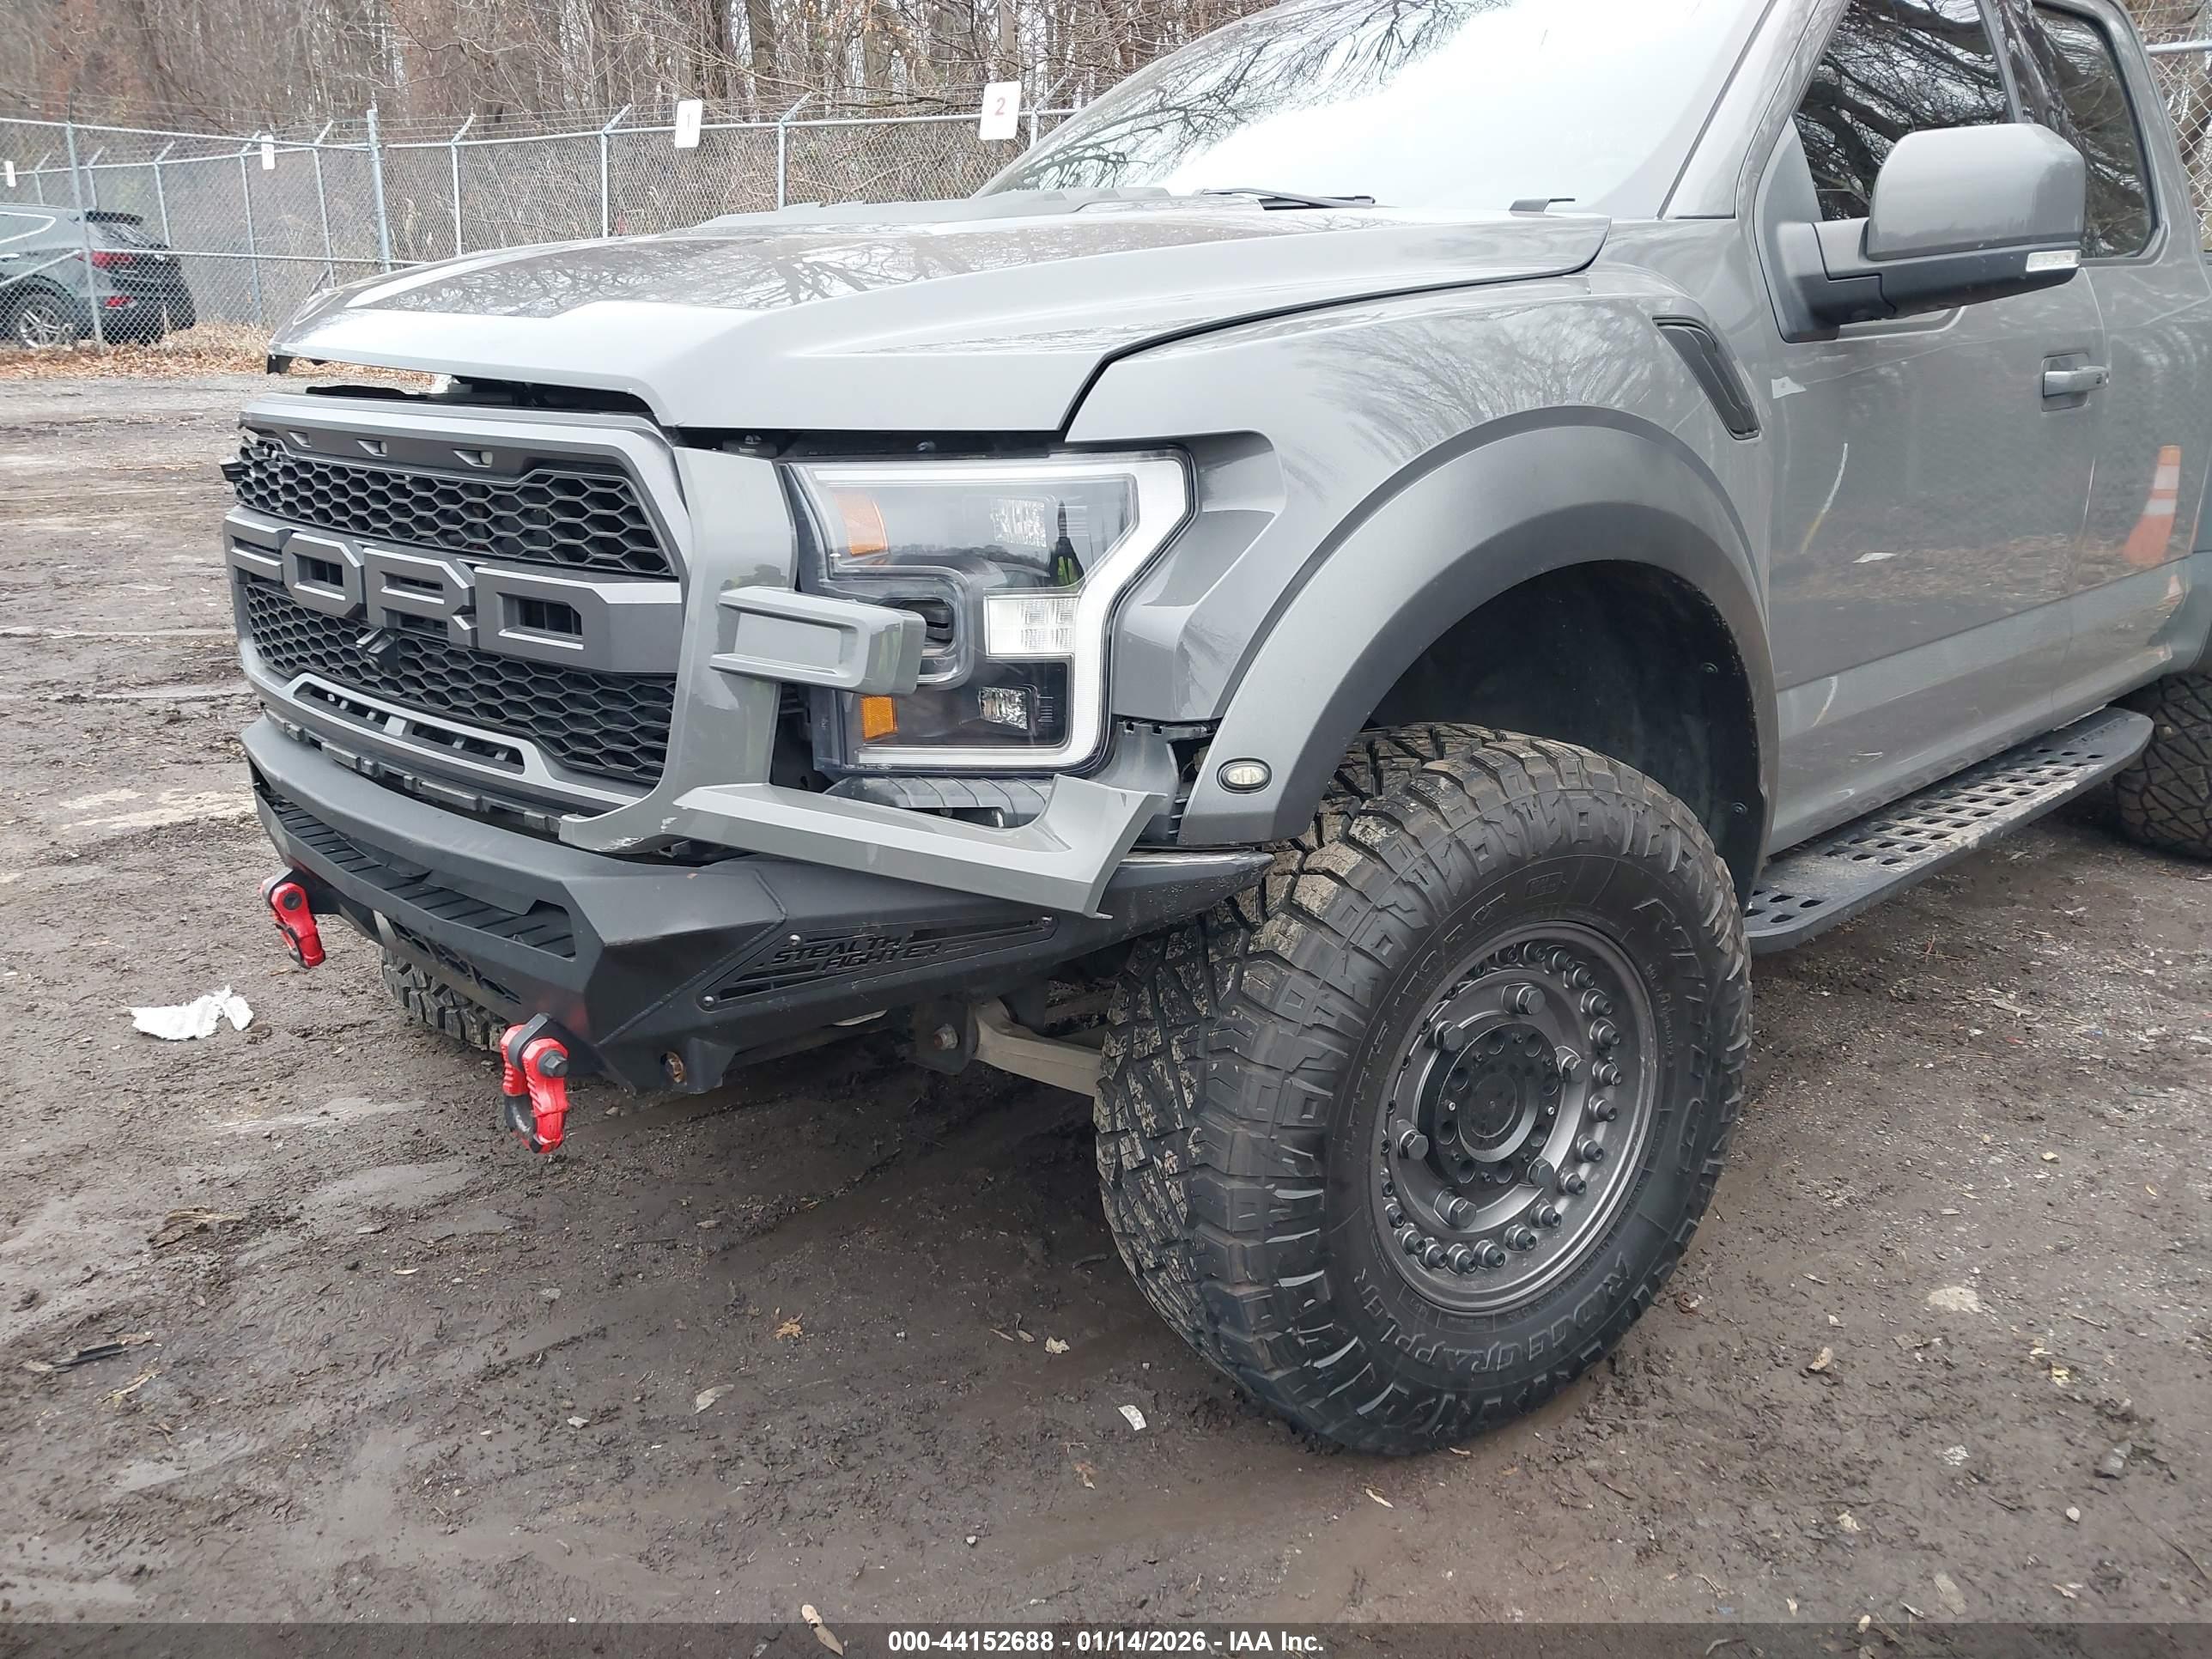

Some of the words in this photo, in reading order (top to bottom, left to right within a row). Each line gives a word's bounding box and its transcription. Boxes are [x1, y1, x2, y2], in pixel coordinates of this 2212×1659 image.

[994, 97, 1006, 117] 2
[224, 507, 681, 673] FORD
[772, 933, 903, 966] STEALTH
[823, 942, 941, 972] FIGHTER
